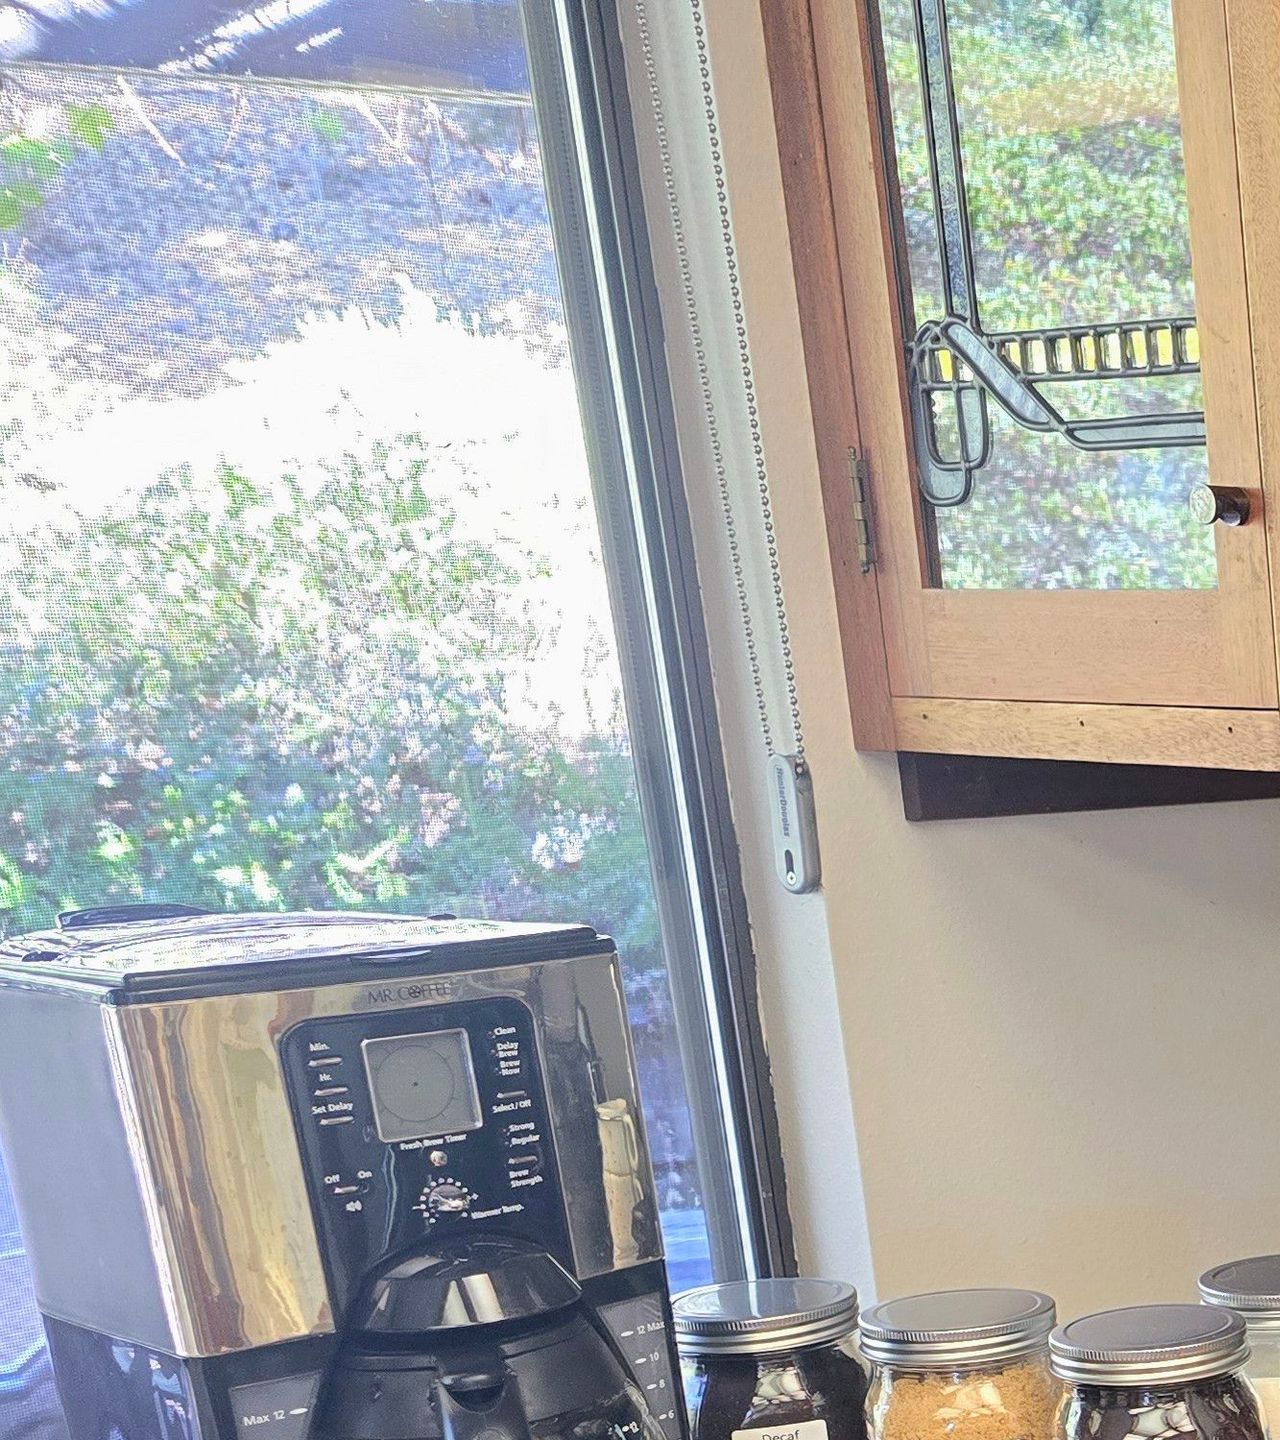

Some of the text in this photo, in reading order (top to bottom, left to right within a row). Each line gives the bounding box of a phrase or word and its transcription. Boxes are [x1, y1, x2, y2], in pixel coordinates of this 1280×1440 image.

[774, 764, 791, 838] HunterDouglas
[494, 1026, 517, 1036] Clean
[497, 1041, 519, 1051] Delay
[499, 1050, 519, 1058] Brew
[500, 1060, 520, 1068] Brew
[501, 1067, 521, 1076] Now
[312, 1101, 354, 1115] Set Delay
[509, 1122, 535, 1132] Strong
[324, 1170, 373, 1184] Off On
[511, 1175, 543, 1188] Strength
[647, 1320, 666, 1333] Max
[649, 1352, 660, 1362] 10
[658, 1379, 666, 1389] 8
[243, 1410, 286, 1427] Max 12
[667, 1409, 675, 1420] 6
